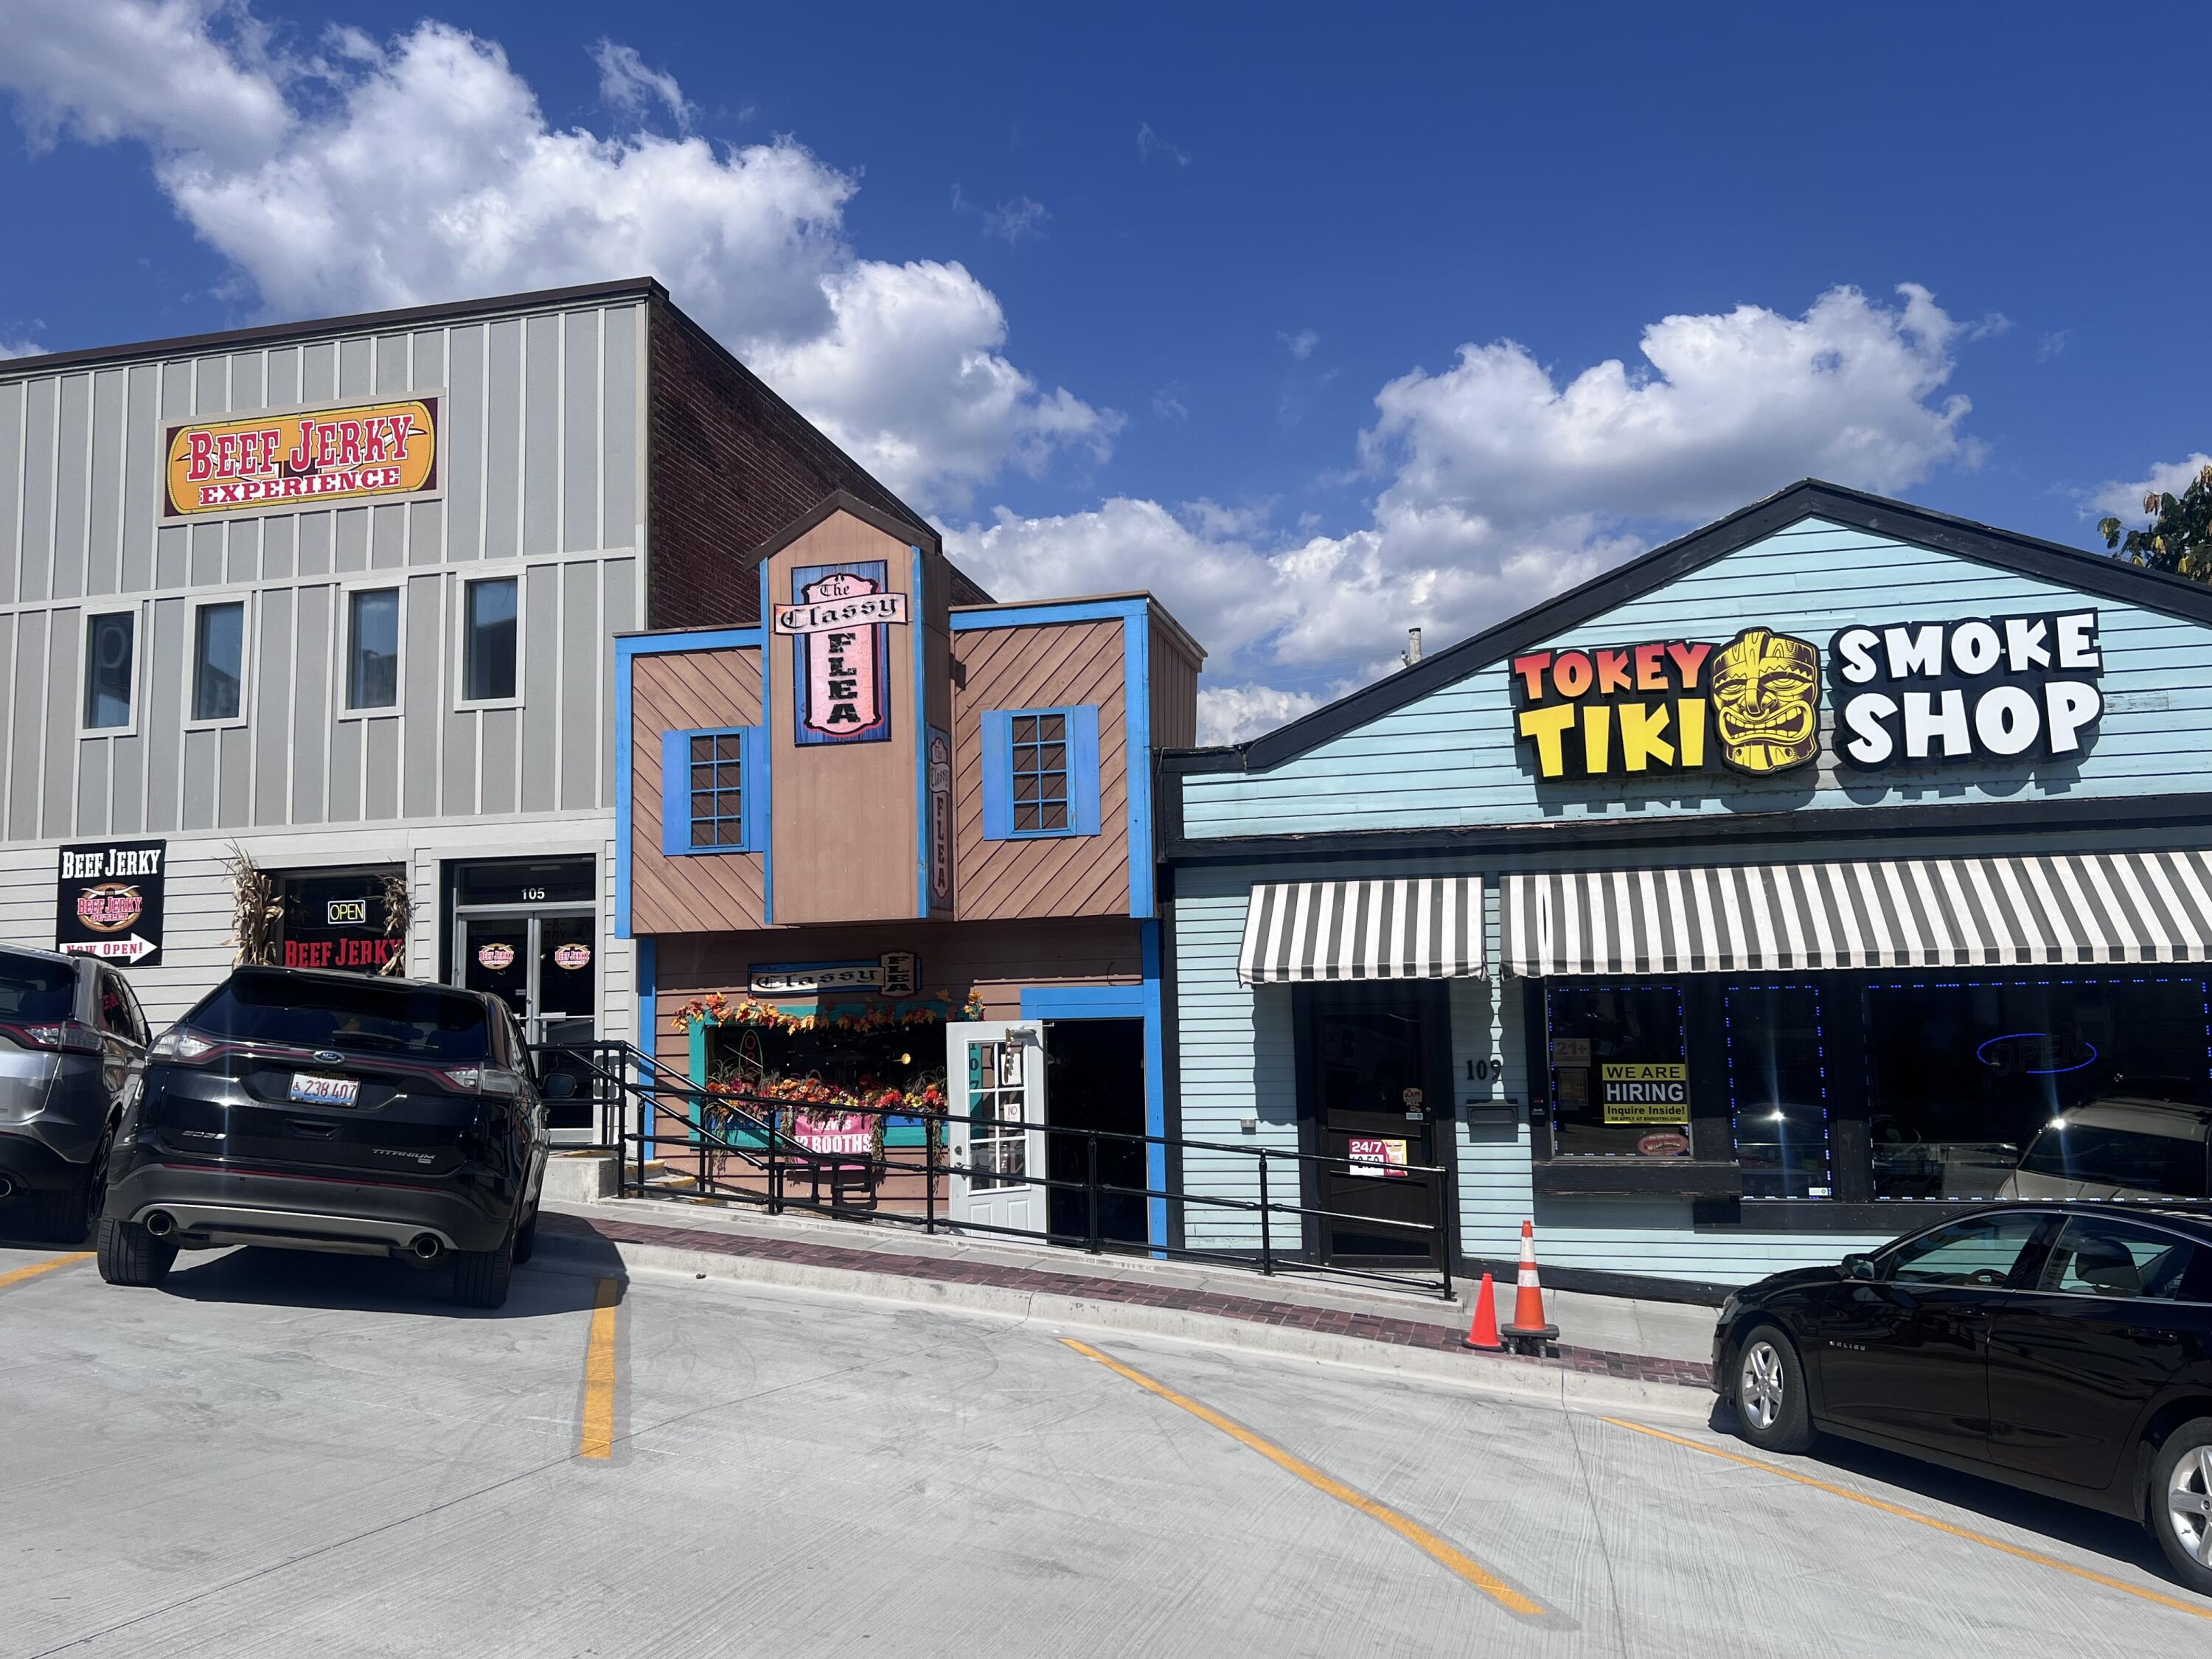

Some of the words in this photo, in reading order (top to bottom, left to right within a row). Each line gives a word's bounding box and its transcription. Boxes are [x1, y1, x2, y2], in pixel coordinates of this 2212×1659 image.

[187, 429, 280, 481] BEEF
[290, 414, 414, 471] JERKY
[199, 467, 400, 506] EXPERIENCE
[818, 582, 849, 597] The
[779, 597, 899, 629] Classy
[1839, 613, 2099, 684] SMOKE
[827, 633, 860, 724] FLEA
[1514, 643, 1712, 700] TOKEY
[1844, 681, 2101, 765] SHOP
[1519, 698, 1705, 777] TIKI
[937, 796, 945, 888] FLEA
[62, 851, 103, 879] BEEF
[105, 849, 161, 877] JERKY
[521, 888, 545, 900] 105
[77, 897, 105, 915] BEEF
[105, 897, 142, 914] JERKY
[330, 903, 364, 920] OPEN
[91, 913, 128, 922] OUTLET
[103, 942, 142, 955] OPEN!
[285, 940, 332, 967] BEEF
[479, 951, 495, 960] BEEF
[494, 950, 514, 960] JERKY
[554, 951, 571, 960] BEEF
[570, 950, 591, 960] JERKY
[756, 970, 878, 990] Classy
[886, 956, 911, 992] FLEA
[1556, 1042, 1587, 1055] 21+
[1467, 1060, 1501, 1084] 109
[1607, 1067, 1636, 1078] WE
[1641, 1067, 1680, 1078] ARE
[305, 1080, 330, 1097] 238
[332, 1083, 357, 1099] 407
[1607, 1083, 1684, 1102] HIRING
[1608, 1106, 1645, 1116] Inquire
[1649, 1106, 1685, 1114] Inside!
[812, 1134, 873, 1153] BOOTHS
[1352, 1141, 1382, 1152] 24/7
[372, 1149, 437, 1159] TITANIUM
